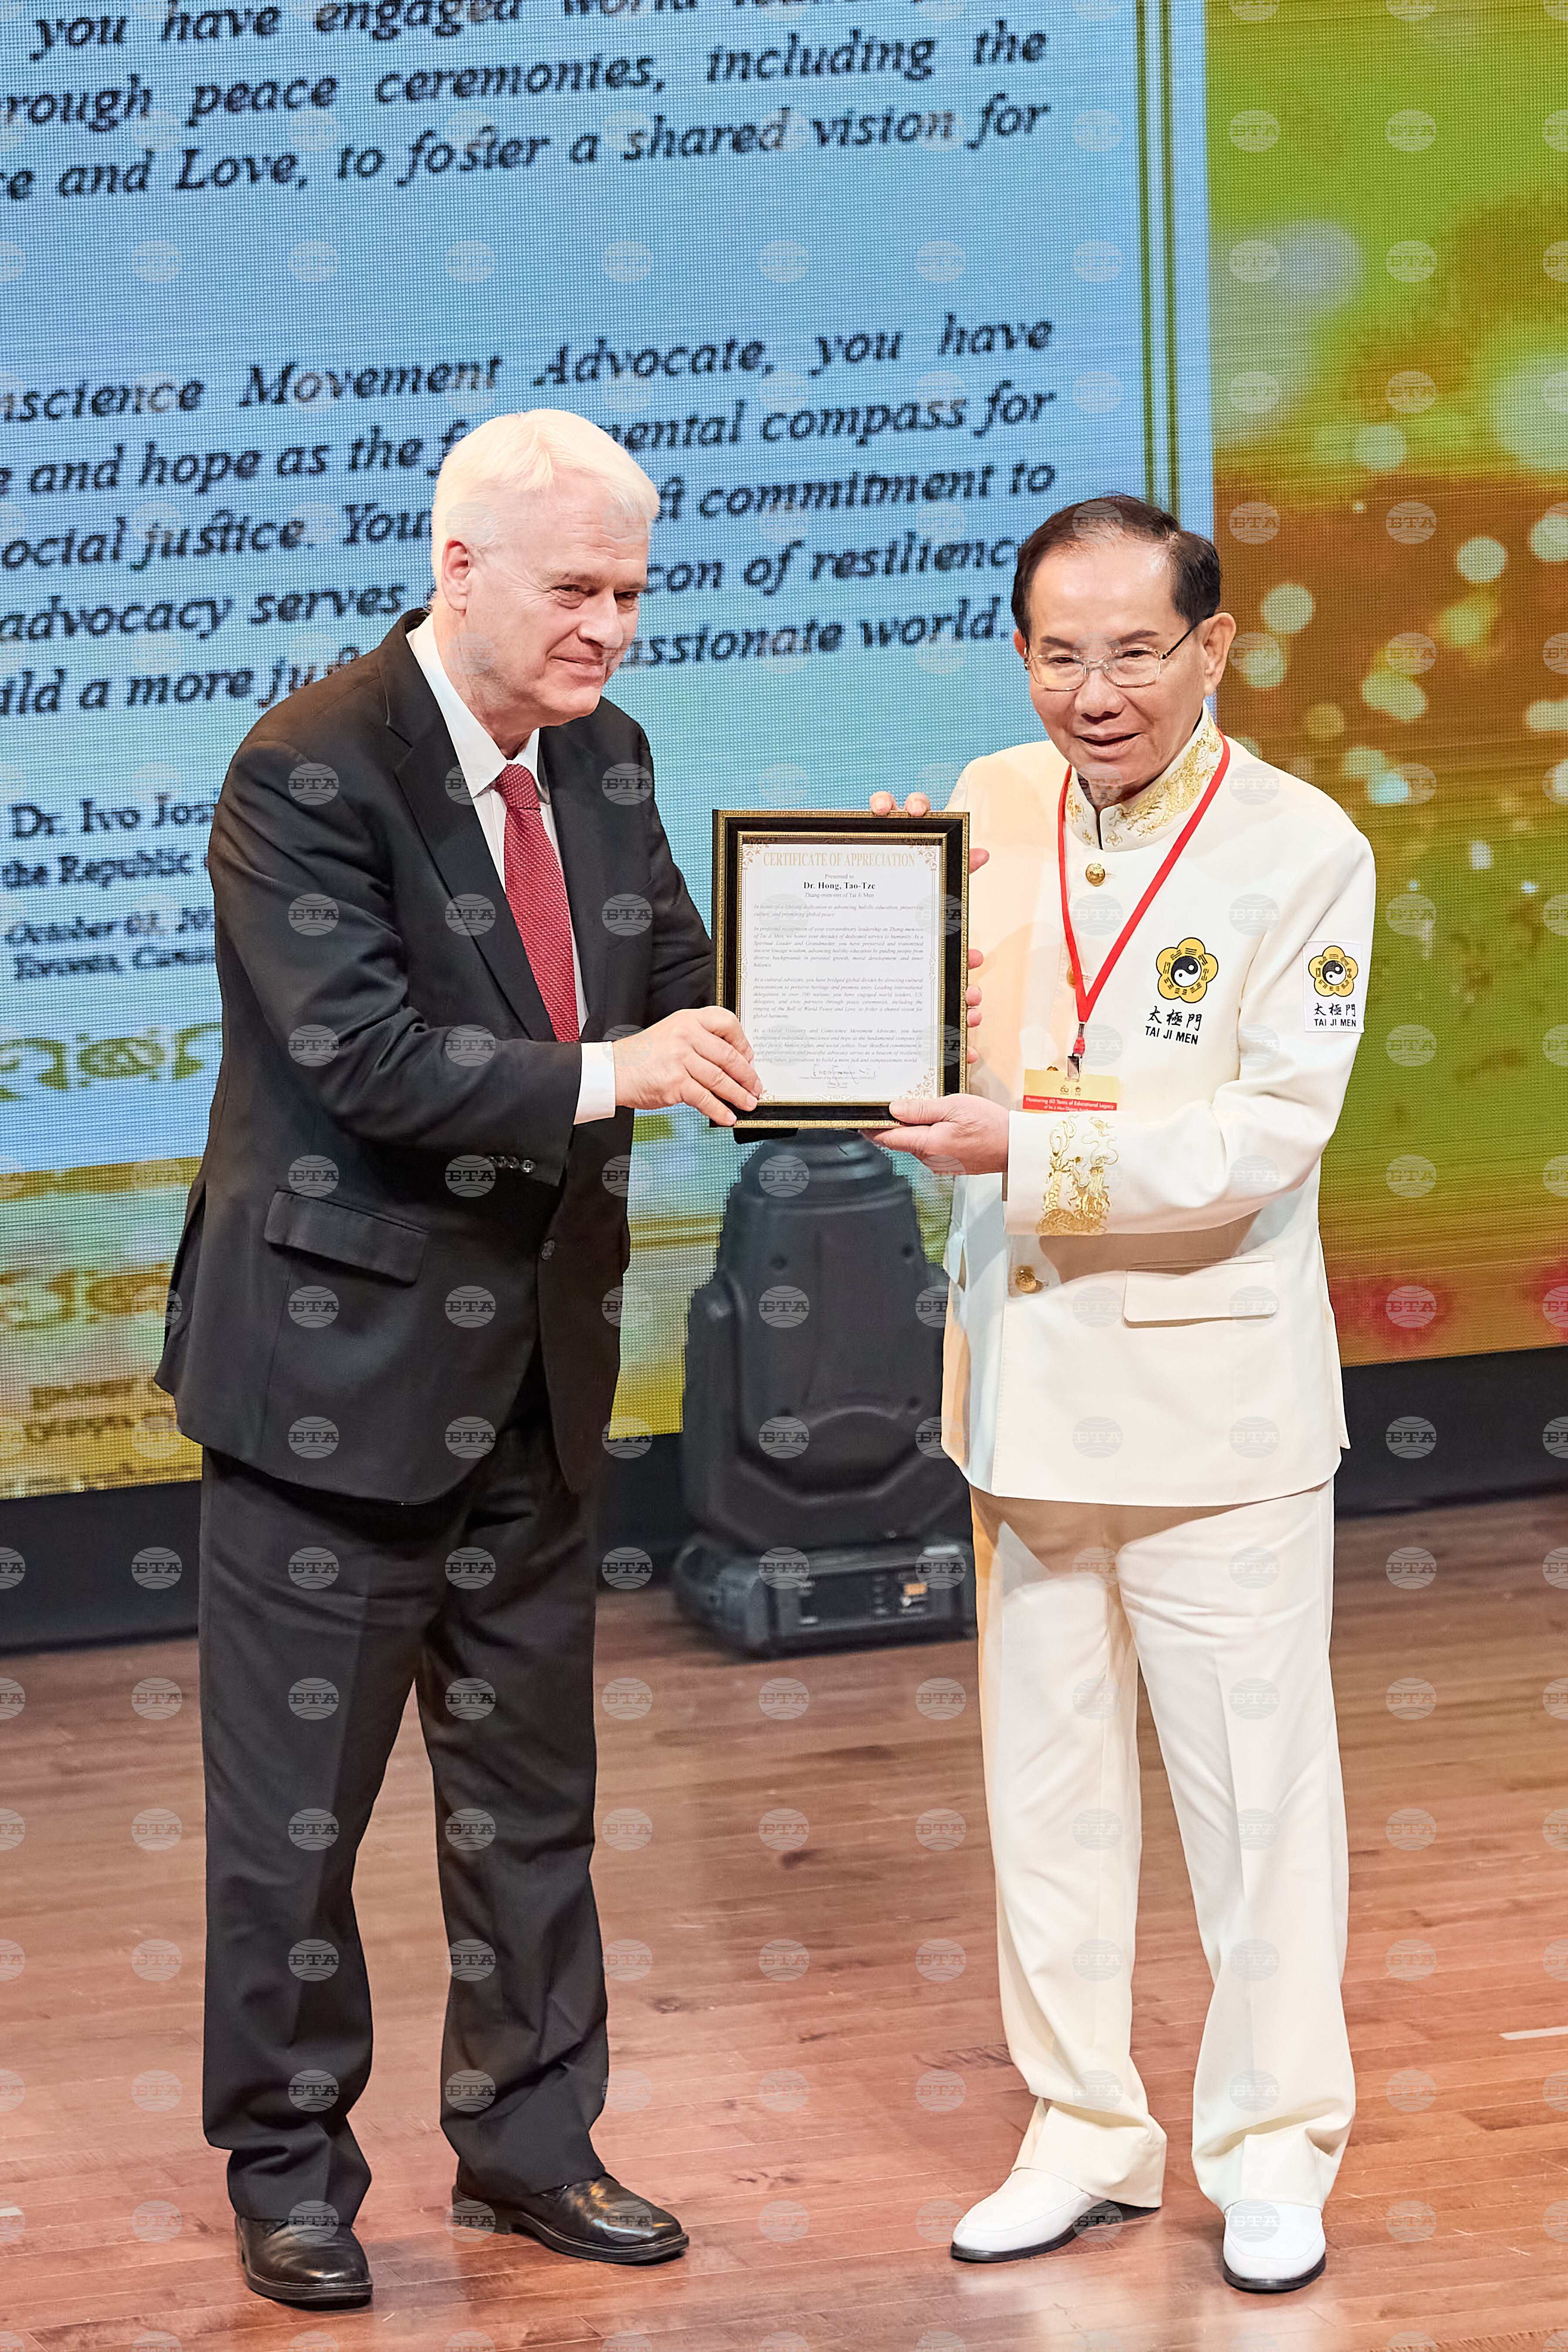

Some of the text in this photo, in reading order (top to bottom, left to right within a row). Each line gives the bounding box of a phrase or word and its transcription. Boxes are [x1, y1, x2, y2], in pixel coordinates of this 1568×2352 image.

[30, 0, 521, 61] you have engaged
[185, 75, 340, 127] peace
[377, 51, 665, 102] ceremonies,
[707, 29, 936, 83] including
[972, 18, 1047, 67] the
[57, 148, 155, 197] and
[173, 146, 308, 192] Love,
[337, 146, 385, 180] to
[395, 125, 551, 187] foster
[569, 132, 601, 166] a
[623, 105, 791, 162] shared
[812, 107, 956, 148] vision
[964, 91, 1052, 151] for
[240, 356, 502, 408] Movement
[533, 338, 774, 388] Advocate,
[809, 331, 903, 378] you
[941, 311, 1053, 356] have
[30, 442, 124, 494] and
[139, 440, 262, 495] hope
[276, 443, 332, 476] as
[350, 423, 423, 472] the
[761, 395, 967, 447] compass
[973, 379, 1058, 437] for
[131, 509, 315, 571] justice.
[699, 463, 996, 519] commitment
[1008, 459, 1058, 496] to
[0, 594, 234, 639] advocacy
[250, 583, 408, 626] serves
[743, 539, 805, 596] of
[79, 678, 111, 711] a
[126, 669, 255, 707] more
[860, 596, 1009, 647] world.
[80, 797, 141, 834] Ivo
[2, 846, 193, 890] the Republic
[763, 852, 916, 867] CERTIFICATE OF APPRECIATION
[818, 882, 841, 890] Hong,
[1146, 1026, 1198, 1045] TAI JI MEN
[1148, 1006, 1202, 1031] 太極門
[1314, 1003, 1356, 1017] 太極門
